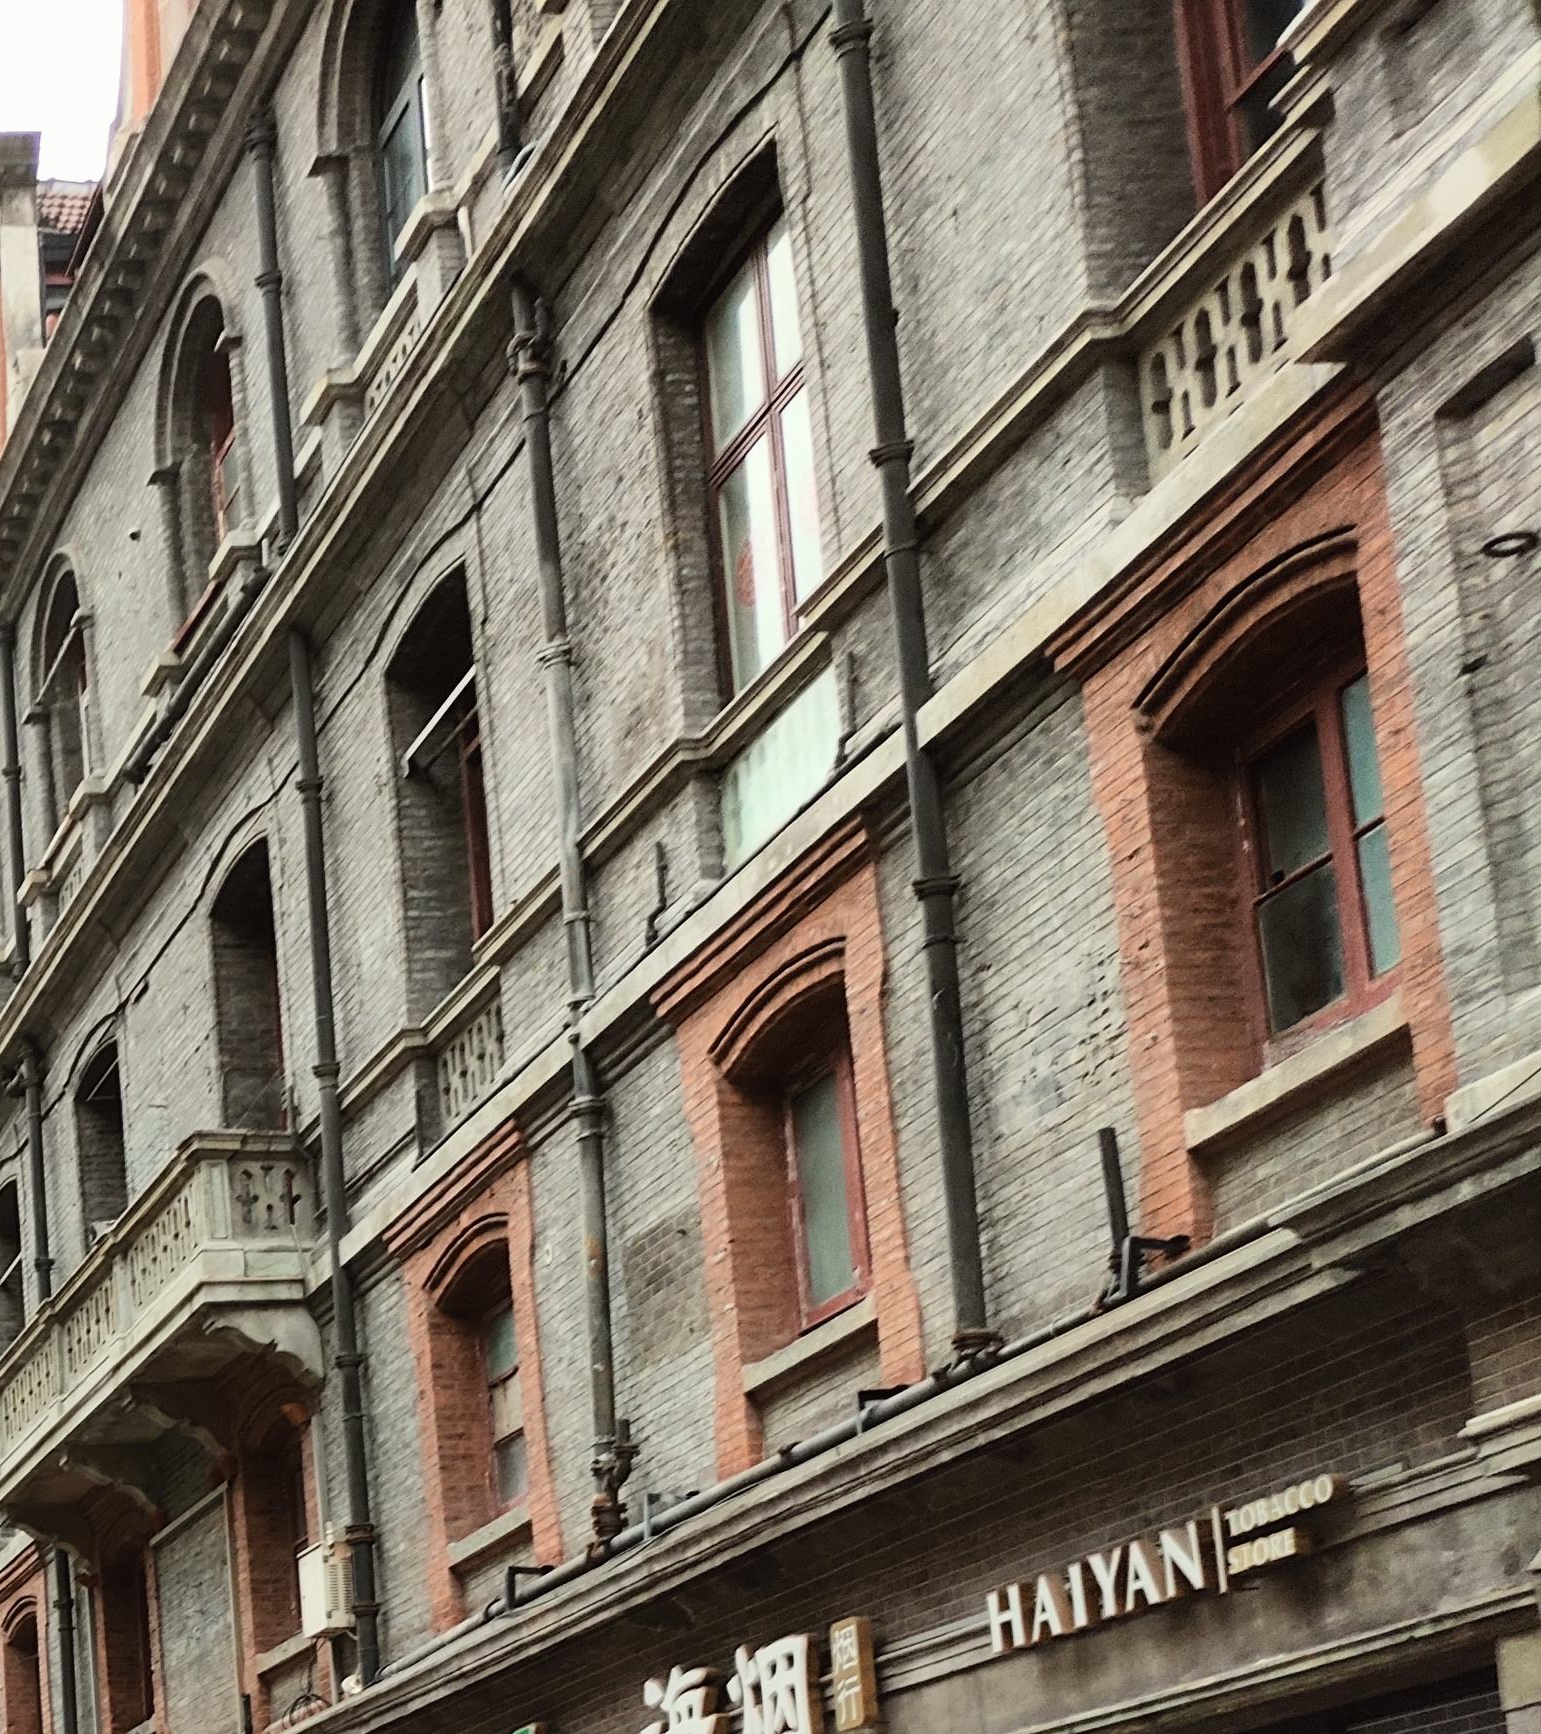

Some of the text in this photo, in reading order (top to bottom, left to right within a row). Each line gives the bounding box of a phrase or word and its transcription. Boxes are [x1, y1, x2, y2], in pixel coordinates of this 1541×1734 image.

[986, 1474, 1335, 1652] HAIYAN TOBACCO
[1227, 1526, 1299, 1576] STORE
[834, 1623, 860, 1727] 烟行
